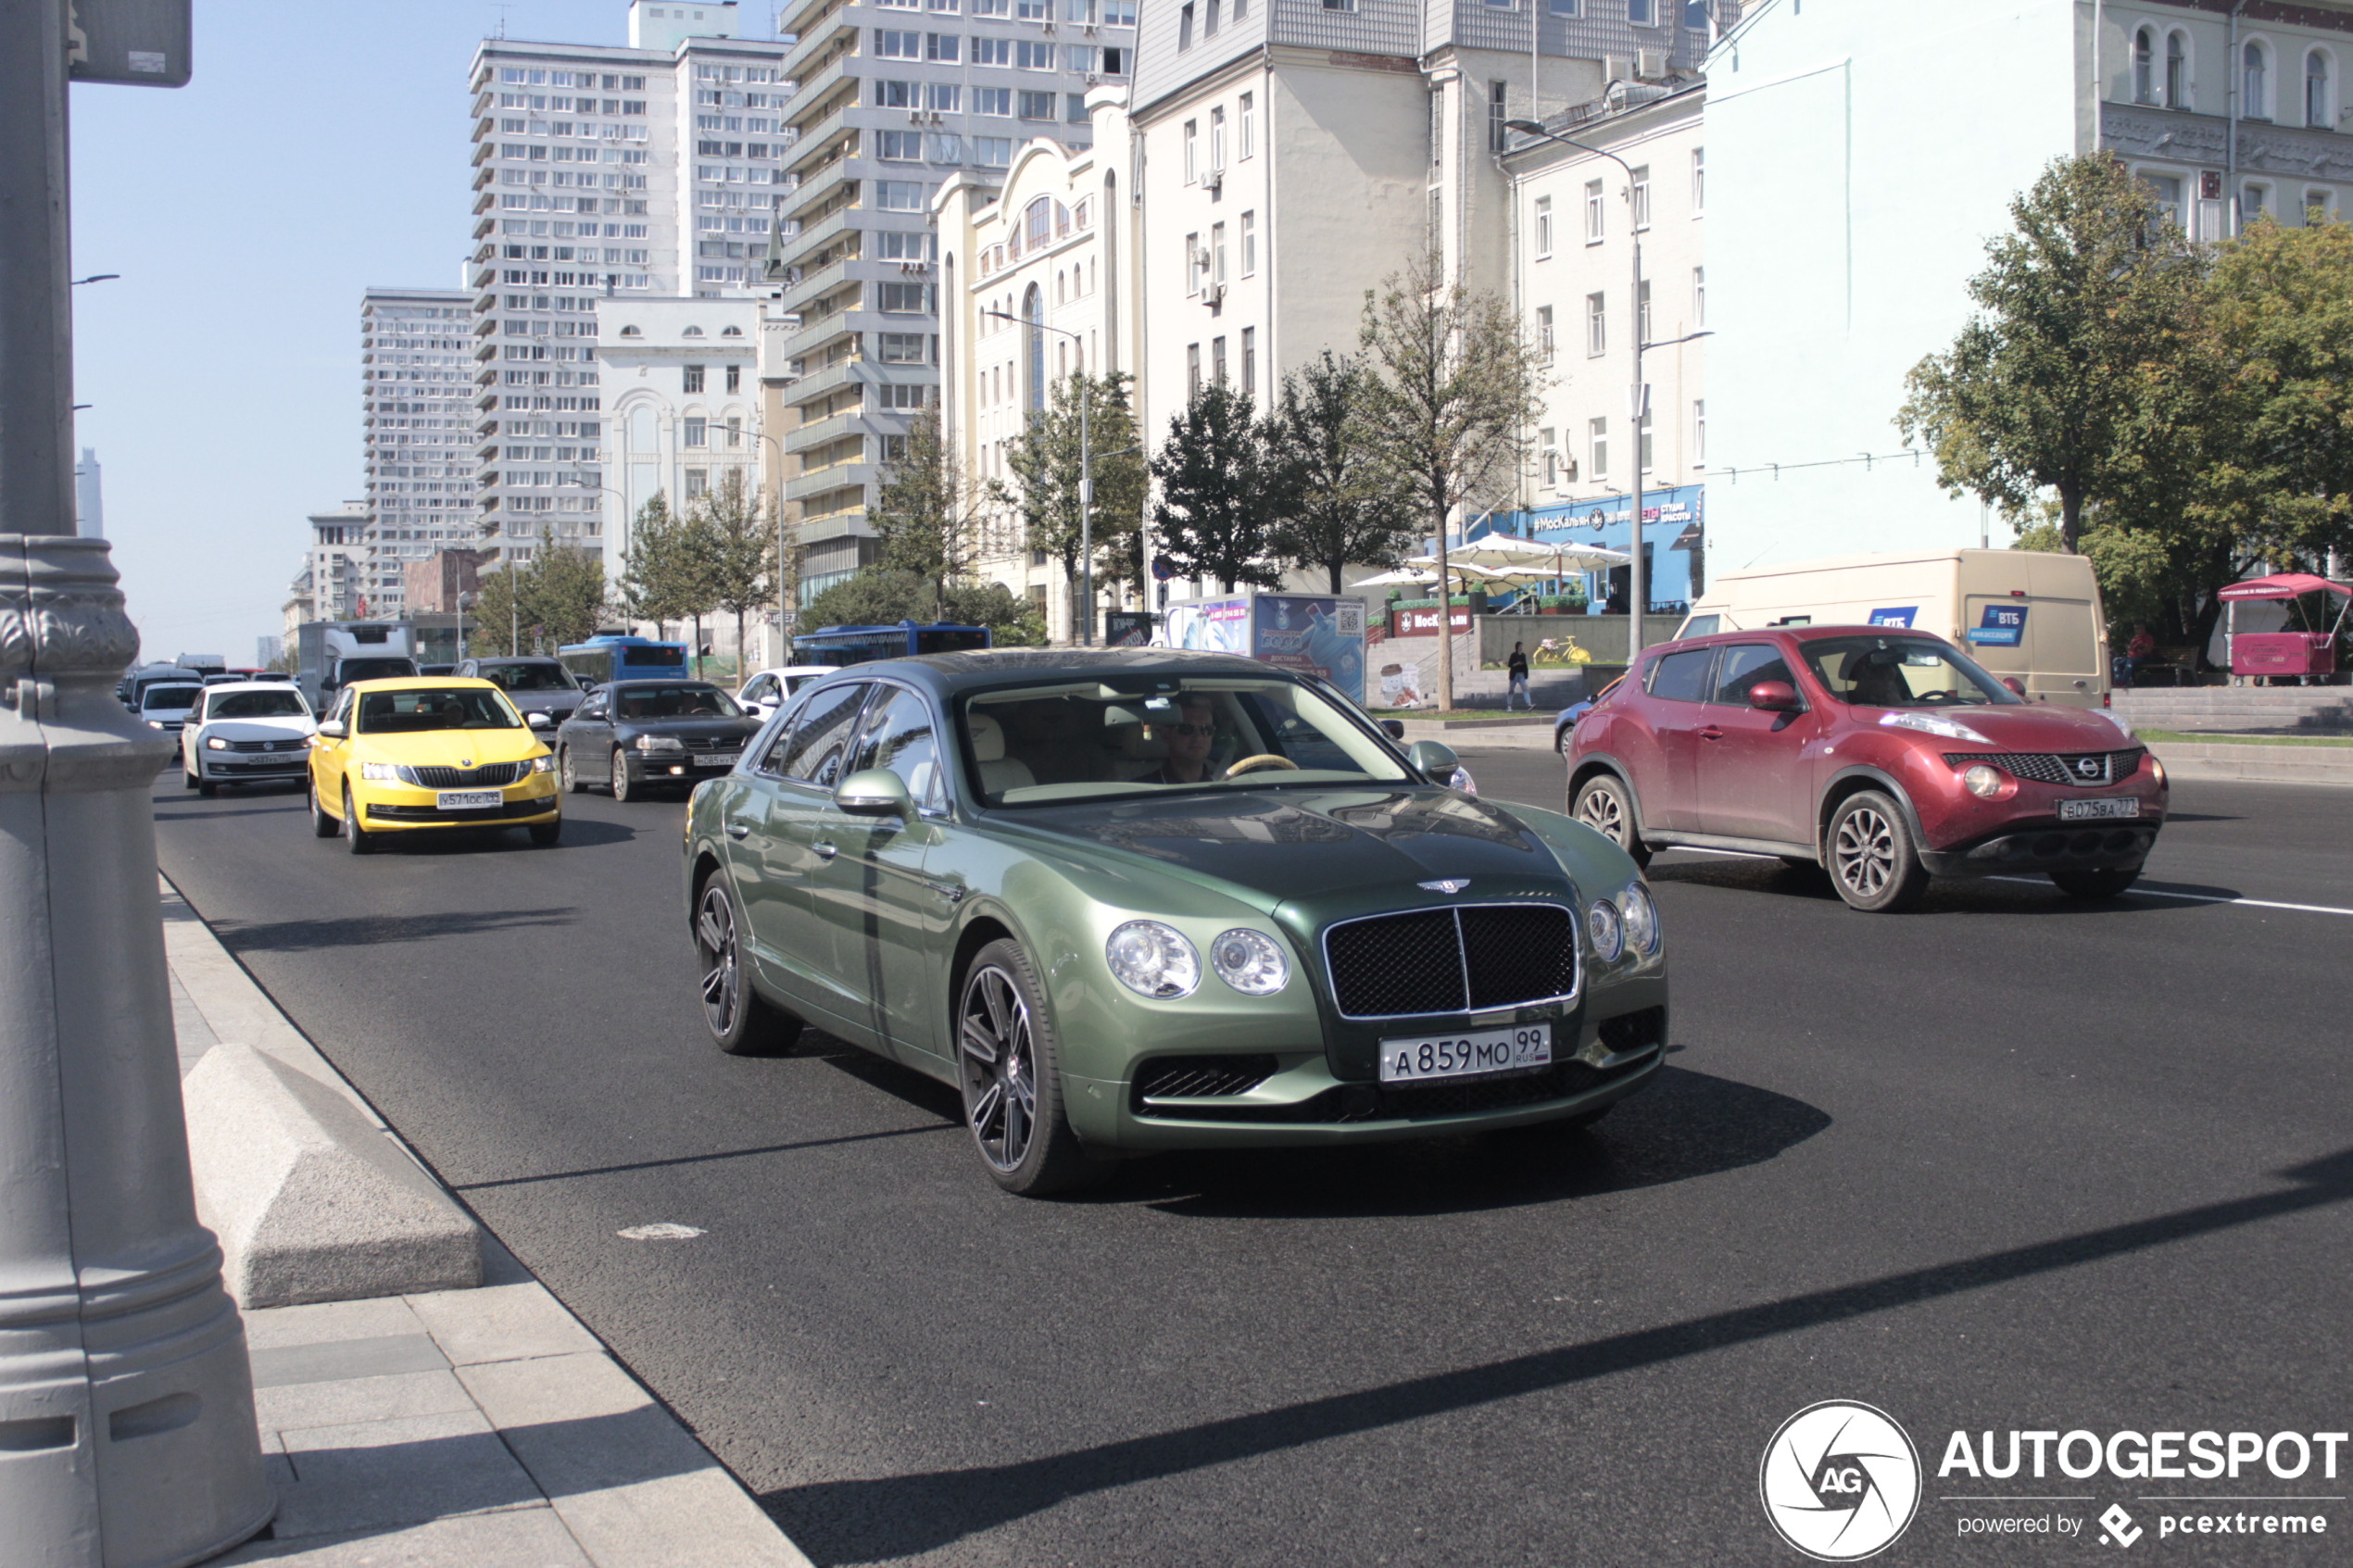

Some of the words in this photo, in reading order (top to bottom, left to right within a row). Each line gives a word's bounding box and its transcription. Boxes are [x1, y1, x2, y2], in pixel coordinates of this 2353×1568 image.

[1534, 515, 1591, 532] #МосКальян
[1415, 612, 1467, 627] МосКьян
[1883, 618, 1906, 628] ВТБ
[1998, 612, 2020, 624] ВТБ
[1270, 655, 1302, 663] ДОСТАВКА
[2068, 802, 2113, 818] В075ВА
[2118, 798, 2135, 811] 777
[1395, 1040, 1510, 1075] А859МО
[1516, 1029, 1541, 1053] 99
[1516, 1053, 1534, 1063] RUS
